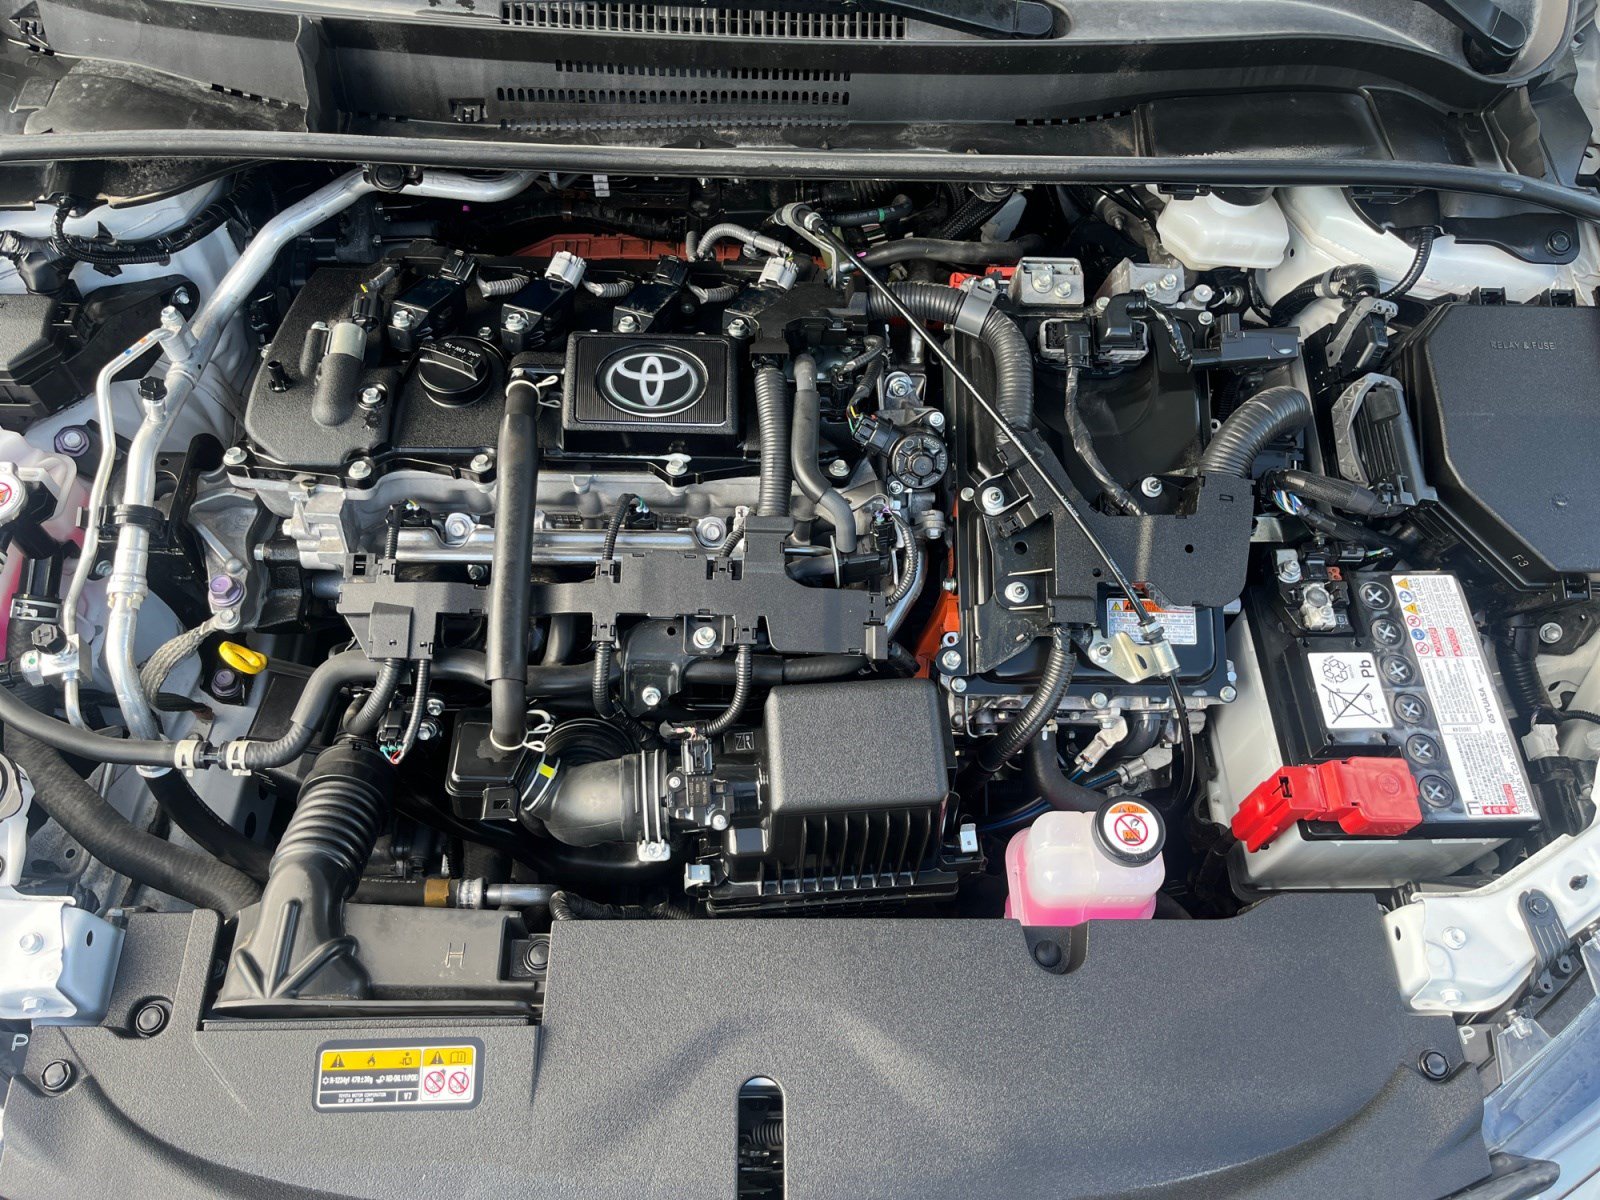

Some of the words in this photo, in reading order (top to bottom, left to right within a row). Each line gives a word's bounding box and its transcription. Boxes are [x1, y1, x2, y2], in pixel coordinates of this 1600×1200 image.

[1490, 341, 1520, 349] RELAY
[1532, 341, 1556, 350] FUSE
[1360, 660, 1374, 678] Pb
[1477, 687, 1492, 713] YUASA
[1486, 713, 1496, 723] GS
[445, 942, 466, 968] H
[11, 1034, 28, 1051] P
[1459, 1026, 1475, 1044] P
